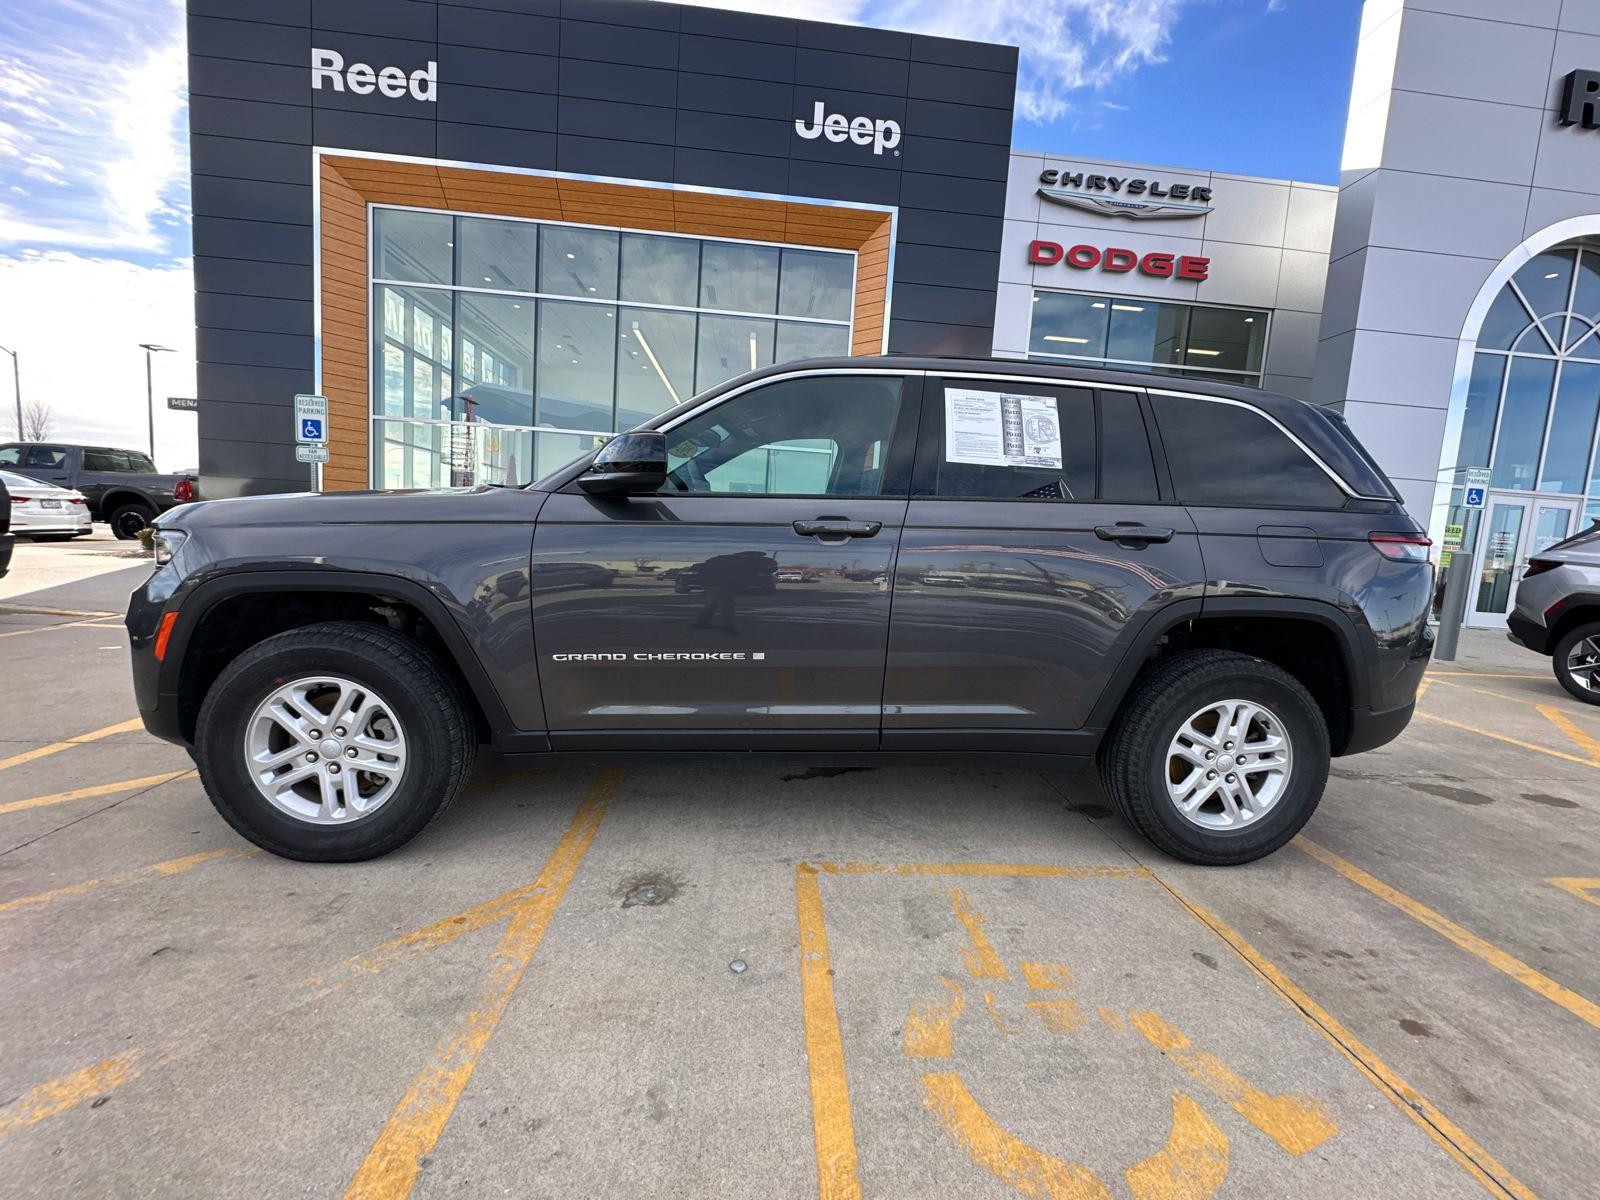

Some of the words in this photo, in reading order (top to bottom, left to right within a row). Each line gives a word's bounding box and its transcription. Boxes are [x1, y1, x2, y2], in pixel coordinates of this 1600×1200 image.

[311, 47, 437, 102] Reed
[795, 101, 901, 155] Jeep
[1040, 169, 1212, 201] CHRYSLER
[1029, 239, 1210, 281] DODGE
[298, 399, 325, 407] RESERVED
[298, 407, 325, 415] PARKING
[552, 653, 627, 661] GRAND
[633, 652, 746, 661] CHEROKEE
